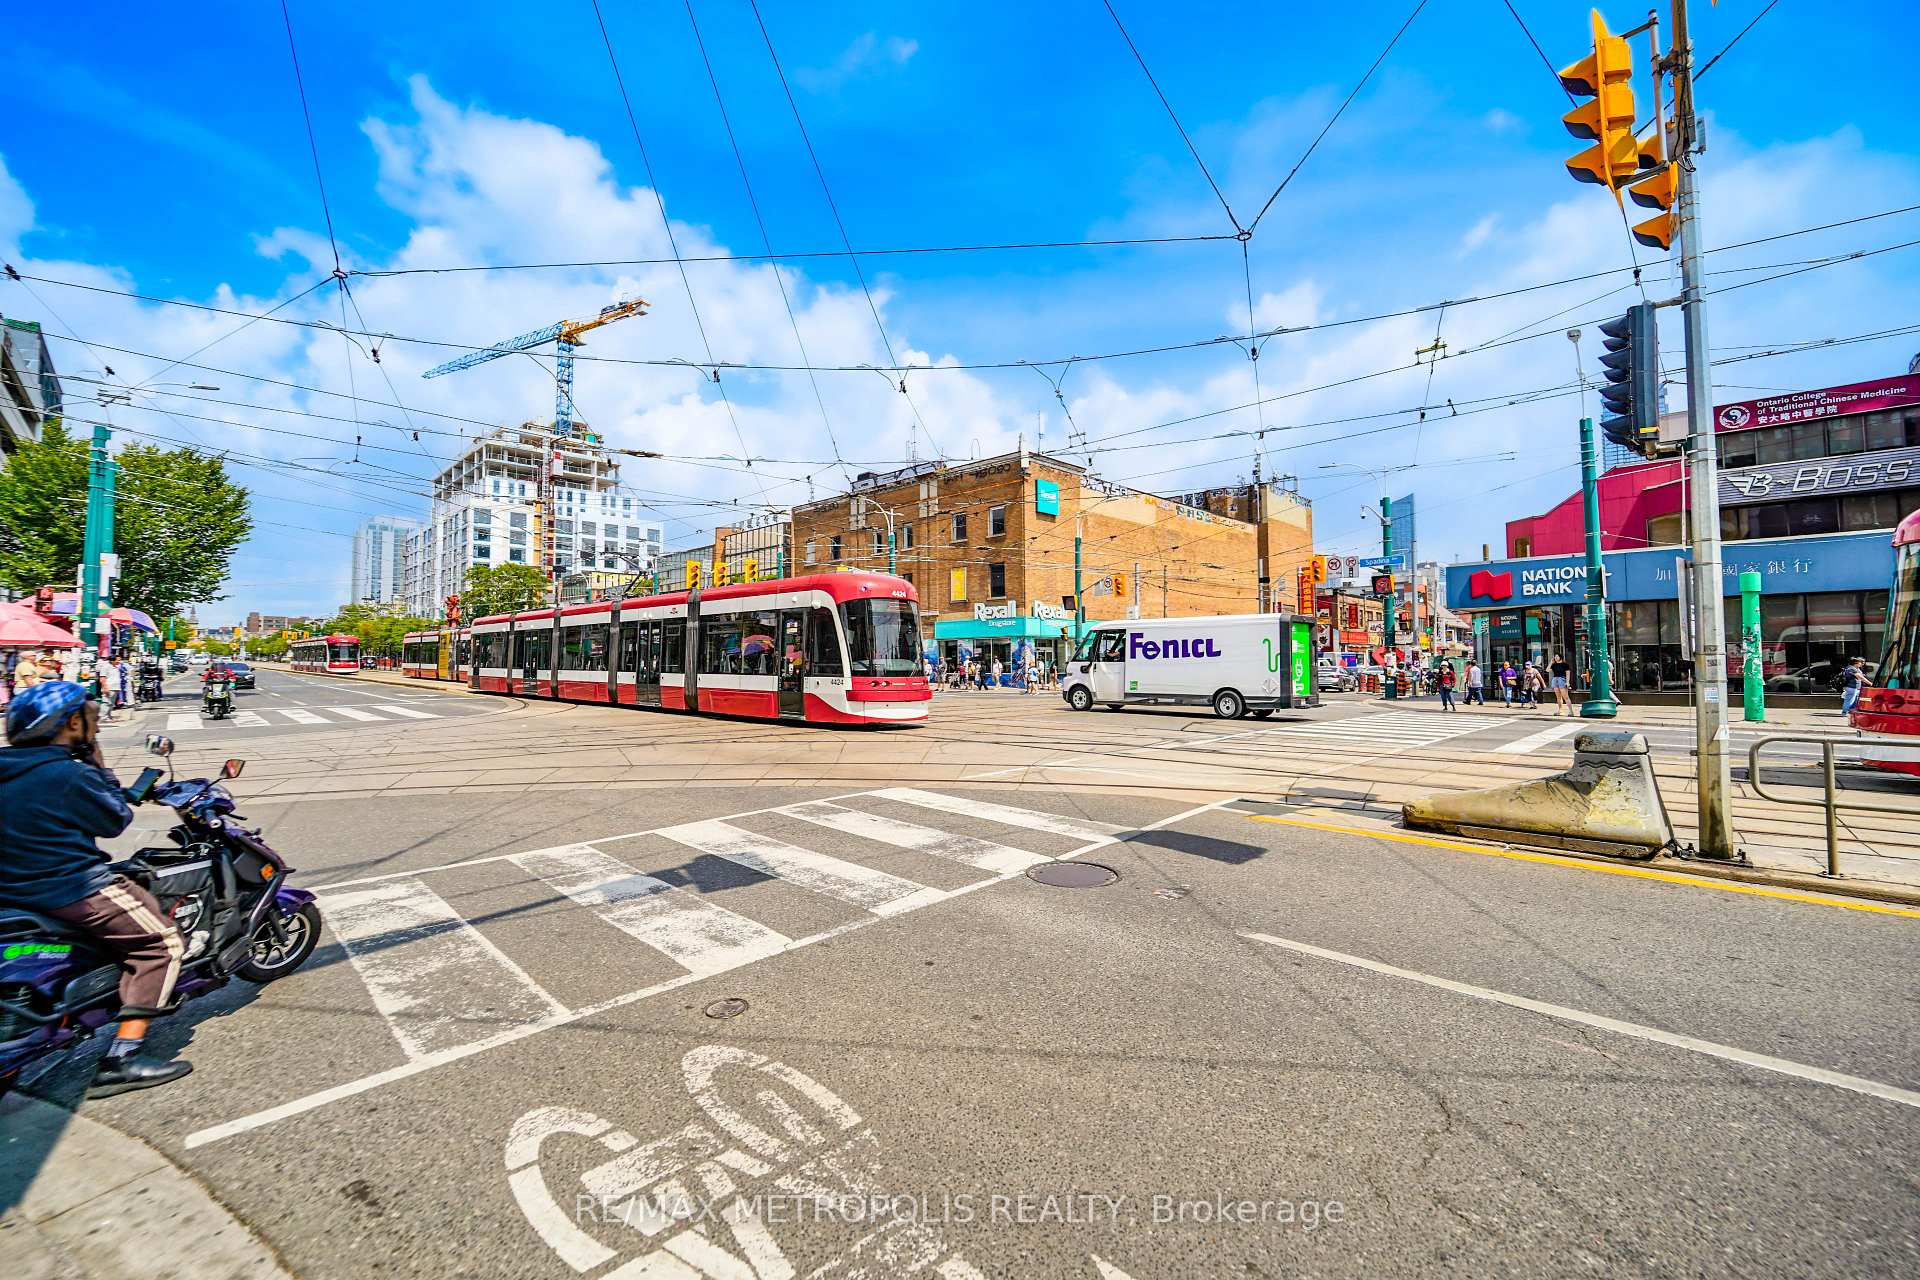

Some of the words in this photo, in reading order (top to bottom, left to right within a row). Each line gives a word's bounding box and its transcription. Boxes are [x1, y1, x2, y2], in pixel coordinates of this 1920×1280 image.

[1756, 398, 1790, 407] Ontario
[1791, 392, 1827, 402] College
[1769, 400, 1818, 413] Traditional
[1820, 394, 1858, 405] Chinese
[1860, 387, 1907, 399] Medicine
[891, 590, 906, 598] 4424
[1523, 581, 1573, 596] BANK
[974, 600, 1017, 622] Rexall
[830, 678, 844, 686] 4424
